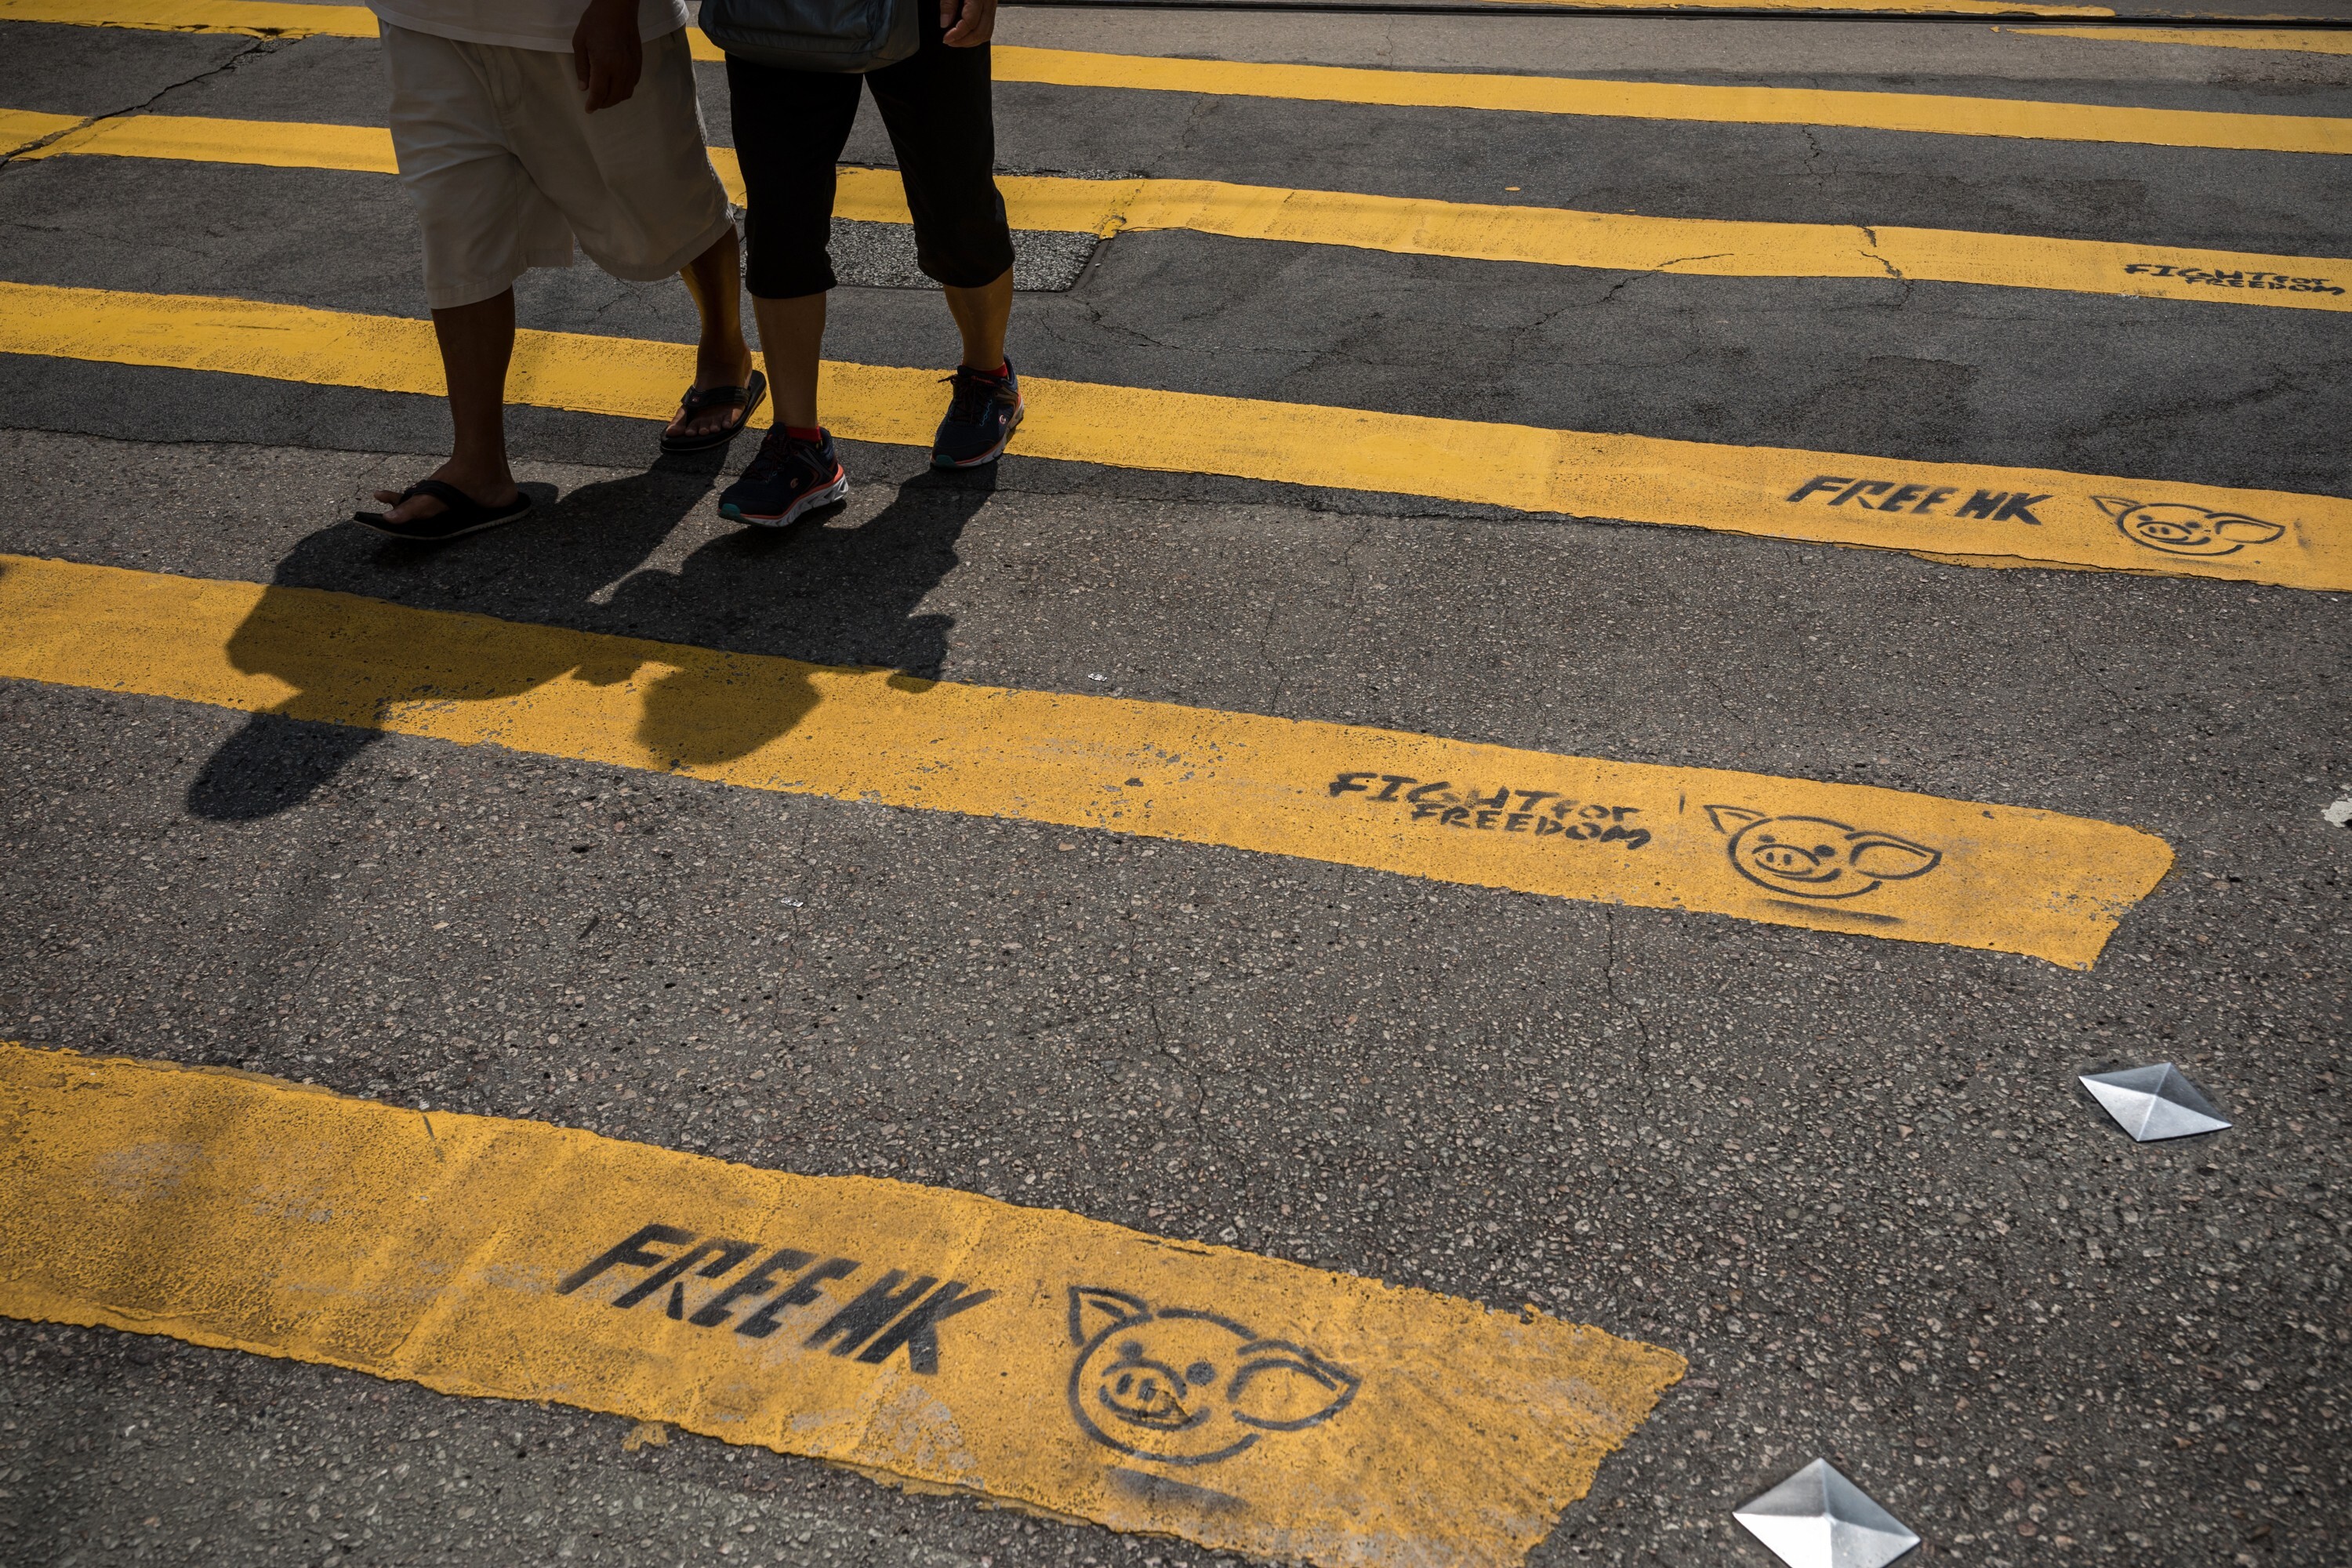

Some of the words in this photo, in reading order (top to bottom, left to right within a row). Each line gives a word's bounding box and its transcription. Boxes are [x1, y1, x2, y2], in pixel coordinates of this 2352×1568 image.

[2124, 263, 2278, 281] FIGHT
[2184, 276, 2346, 296] FREEDOM
[1786, 474, 1958, 514] FREE
[1954, 488, 2055, 526] HK
[1329, 772, 1563, 812] FIGHT
[1410, 802, 1652, 851] FREEDOM
[554, 1223, 862, 1338] FREE
[803, 1268, 998, 1376] HK
